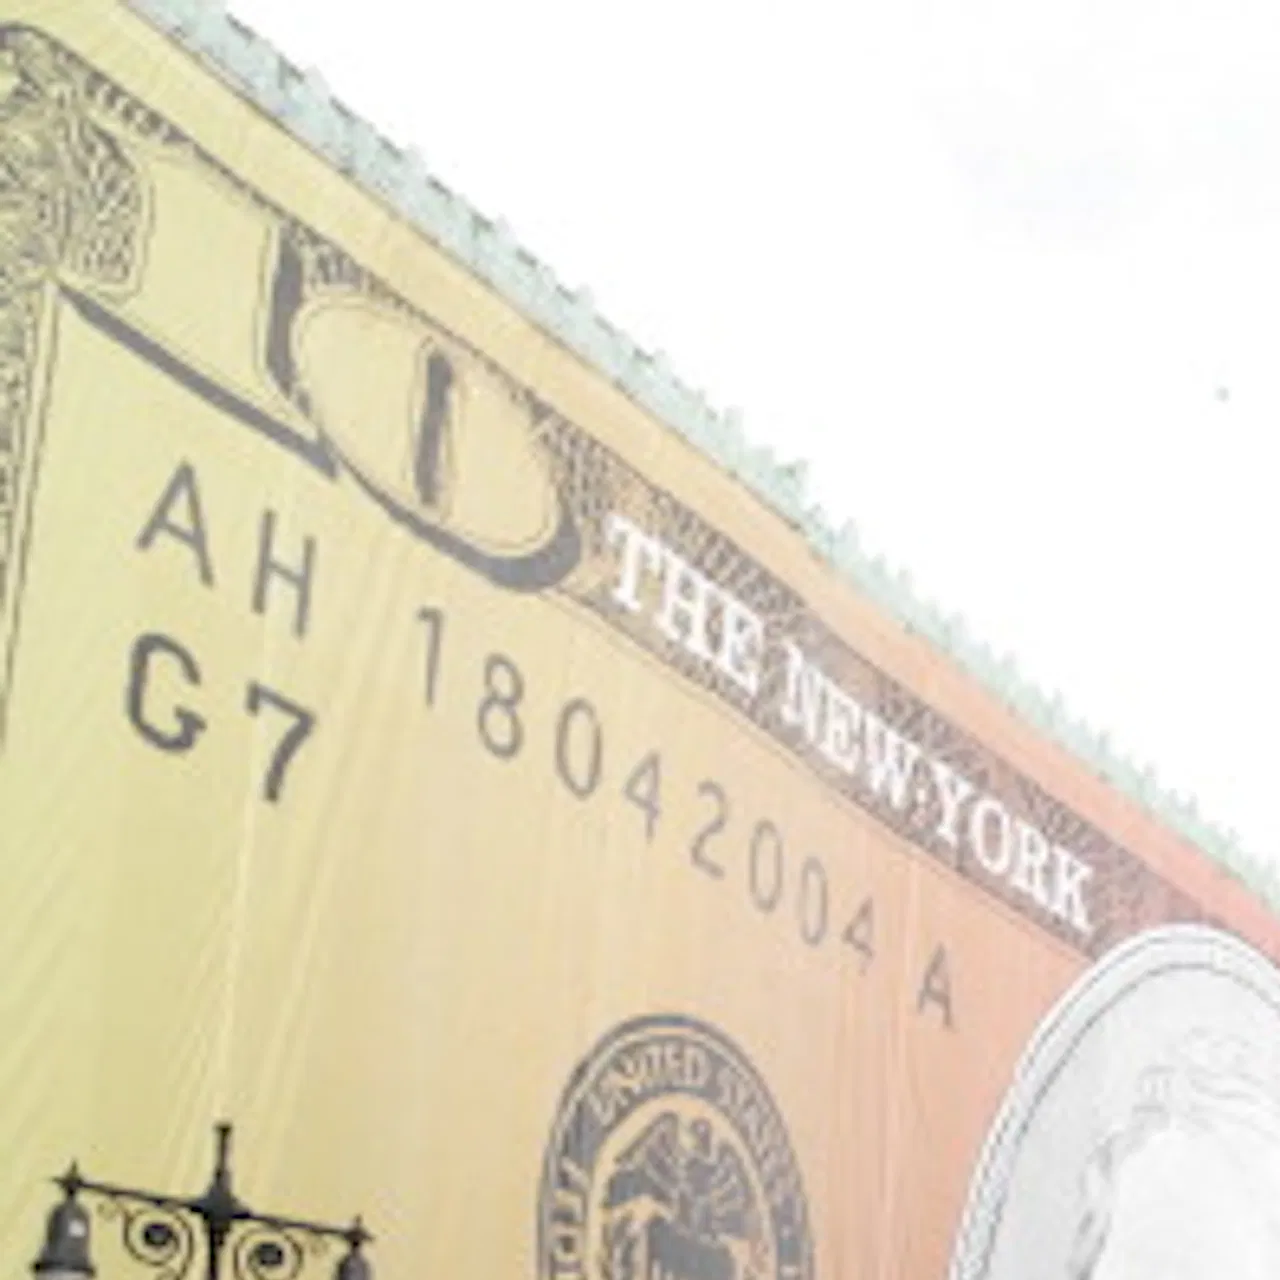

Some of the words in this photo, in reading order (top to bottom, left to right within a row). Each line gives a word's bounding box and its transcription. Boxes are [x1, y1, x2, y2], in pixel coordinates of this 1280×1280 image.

[126, 632, 318, 803] G7
[417, 607, 877, 975] 18042004
[916, 943, 957, 1032] A
[606, 513, 766, 697] THE
[779, 646, 914, 809] NEW
[926, 762, 1095, 936] YORK
